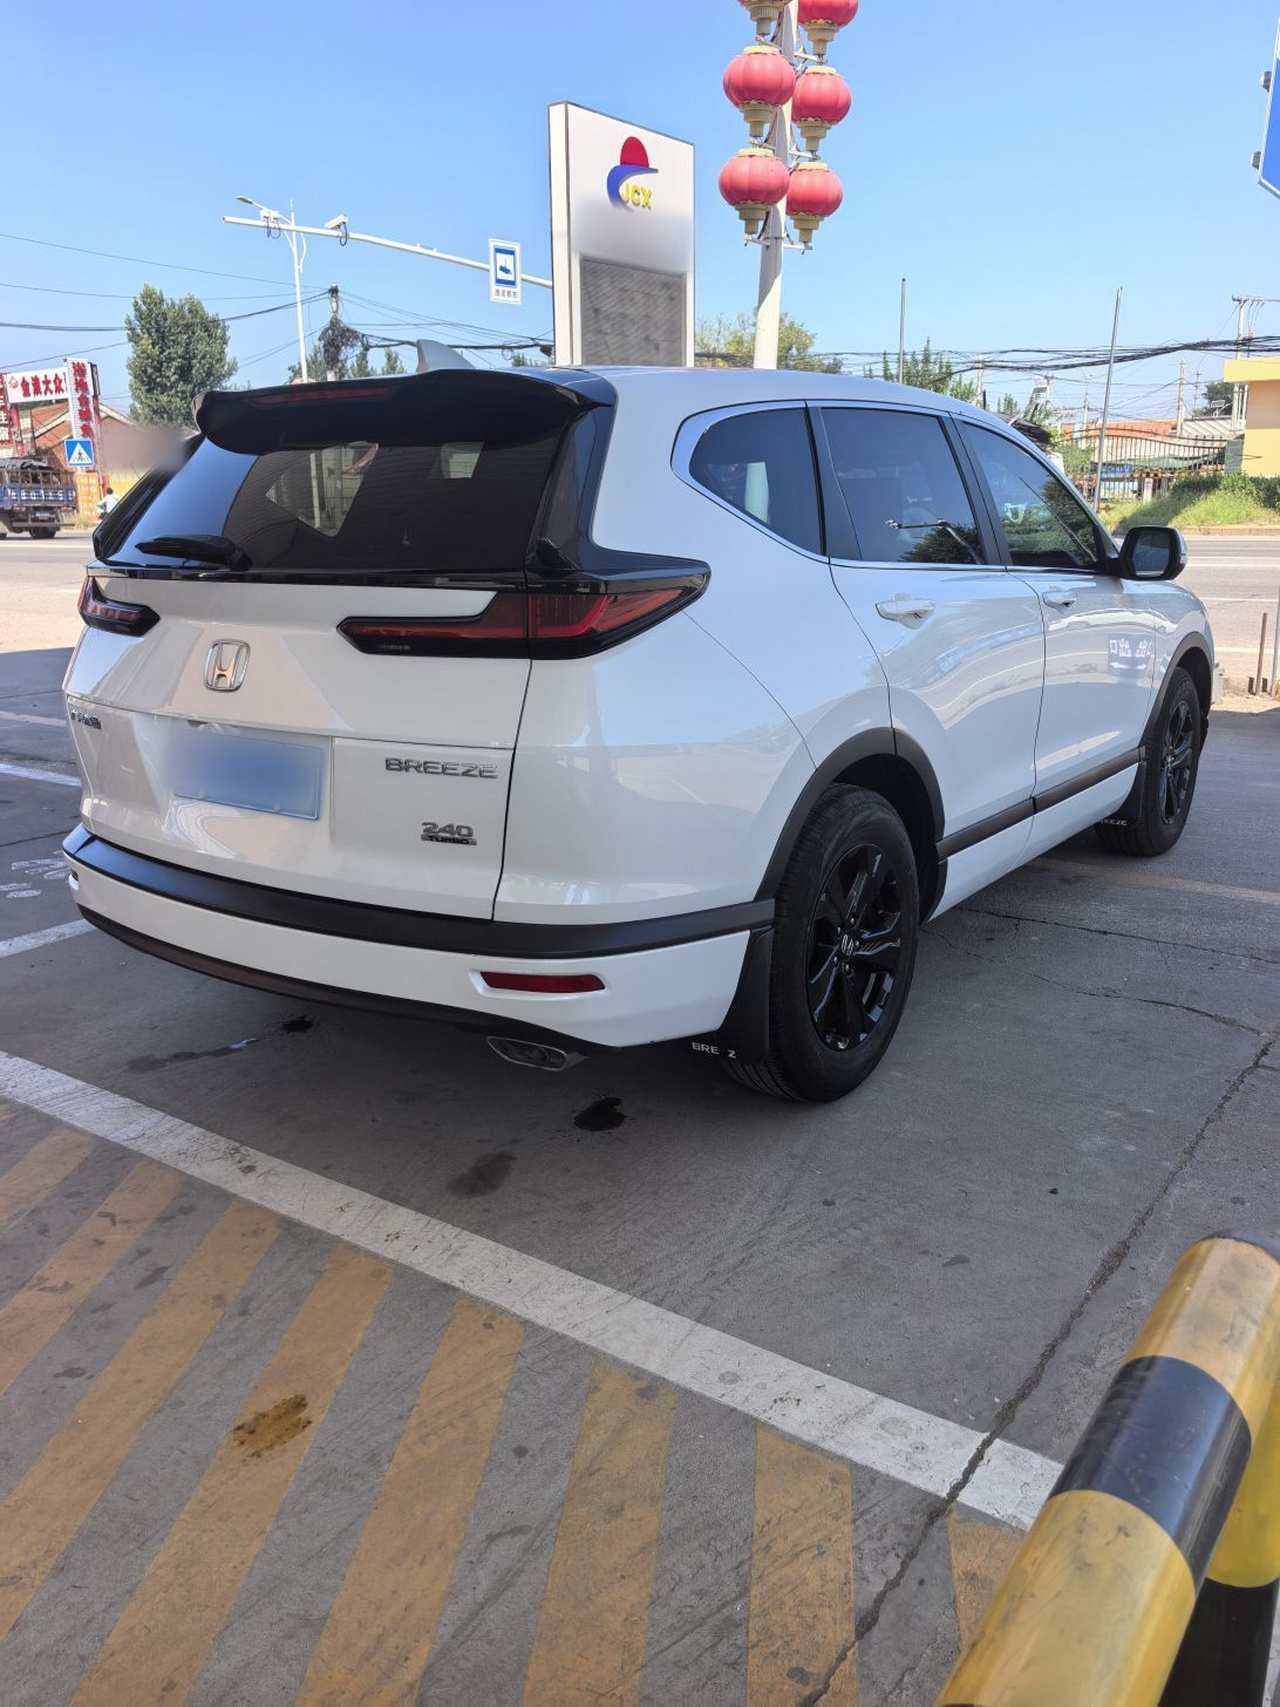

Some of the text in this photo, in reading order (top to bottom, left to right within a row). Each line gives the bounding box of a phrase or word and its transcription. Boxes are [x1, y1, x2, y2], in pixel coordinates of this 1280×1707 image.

[620, 181, 653, 209] JCX
[385, 757, 499, 779] BREEZE
[422, 821, 474, 838] 240
